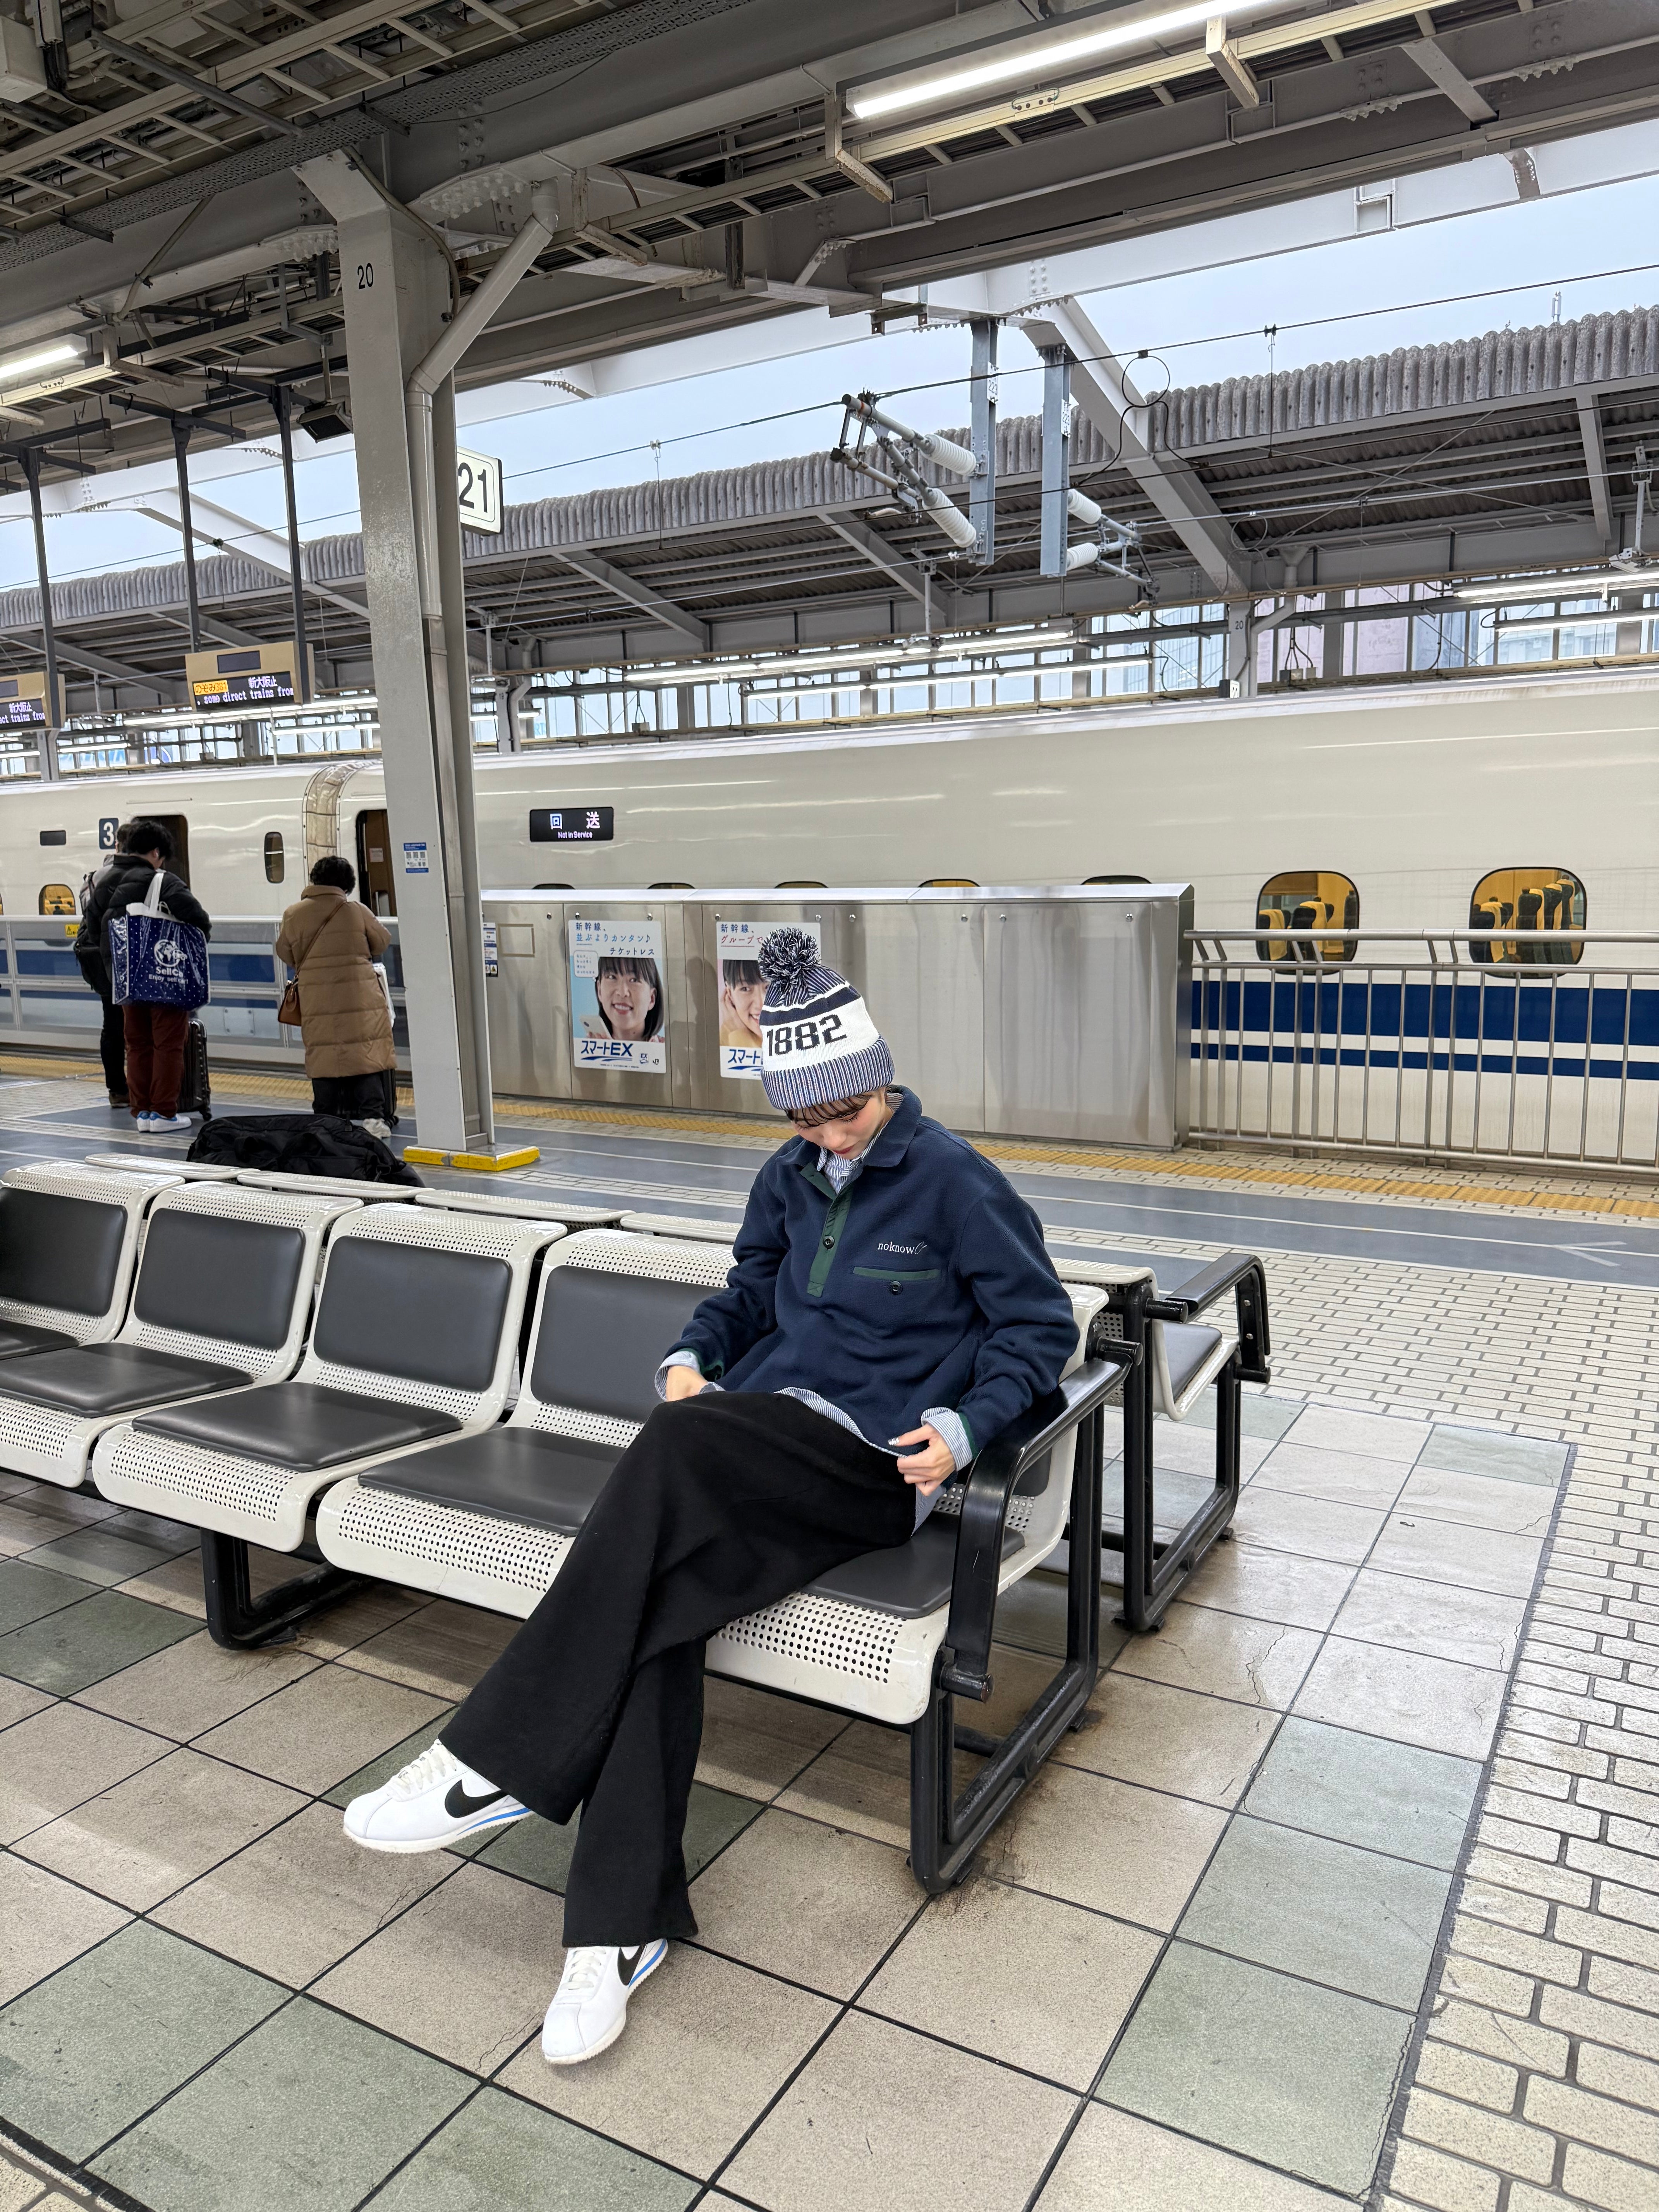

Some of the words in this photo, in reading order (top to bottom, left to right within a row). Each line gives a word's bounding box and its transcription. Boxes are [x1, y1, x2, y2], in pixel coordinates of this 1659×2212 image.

[357, 263, 374, 290] 20
[458, 462, 488, 513] 21
[1235, 620, 1243, 630] 20
[204, 695, 220, 704] some
[223, 692, 247, 702] direct
[250, 688, 274, 699] trains
[103, 821, 114, 847] 3
[610, 947, 654, 955] チケットレス
[149, 974, 165, 982] Enjoy
[766, 1013, 847, 1056] 1882
[581, 1040, 634, 1057] スマートEX
[728, 1049, 763, 1065] スマート
[877, 1241, 915, 1254] noknow
